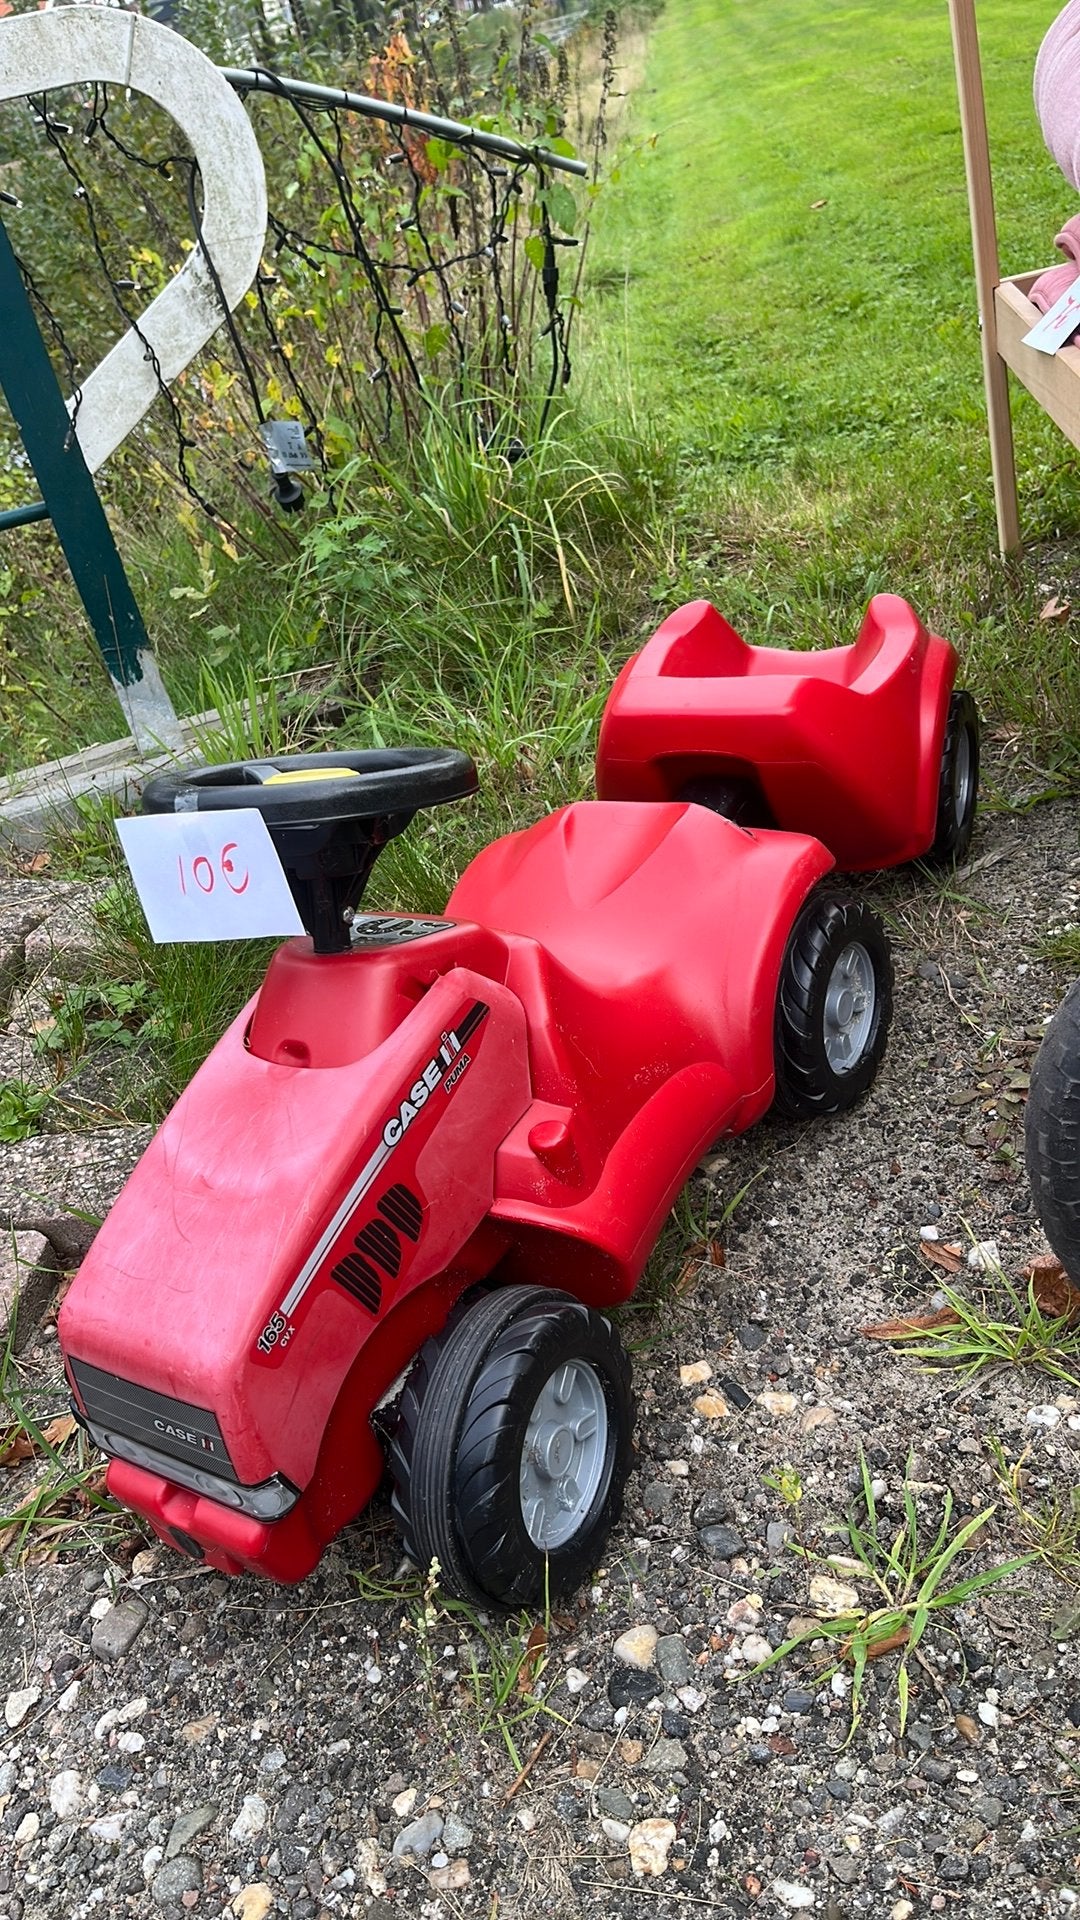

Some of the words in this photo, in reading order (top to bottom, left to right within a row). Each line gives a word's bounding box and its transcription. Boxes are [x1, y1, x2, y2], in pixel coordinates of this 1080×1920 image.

[177, 842, 249, 895] 10€
[443, 1052, 472, 1095] PUMA
[383, 1059, 443, 1148] CASE
[257, 1310, 287, 1354] 165
[154, 1420, 198, 1445] CASE
